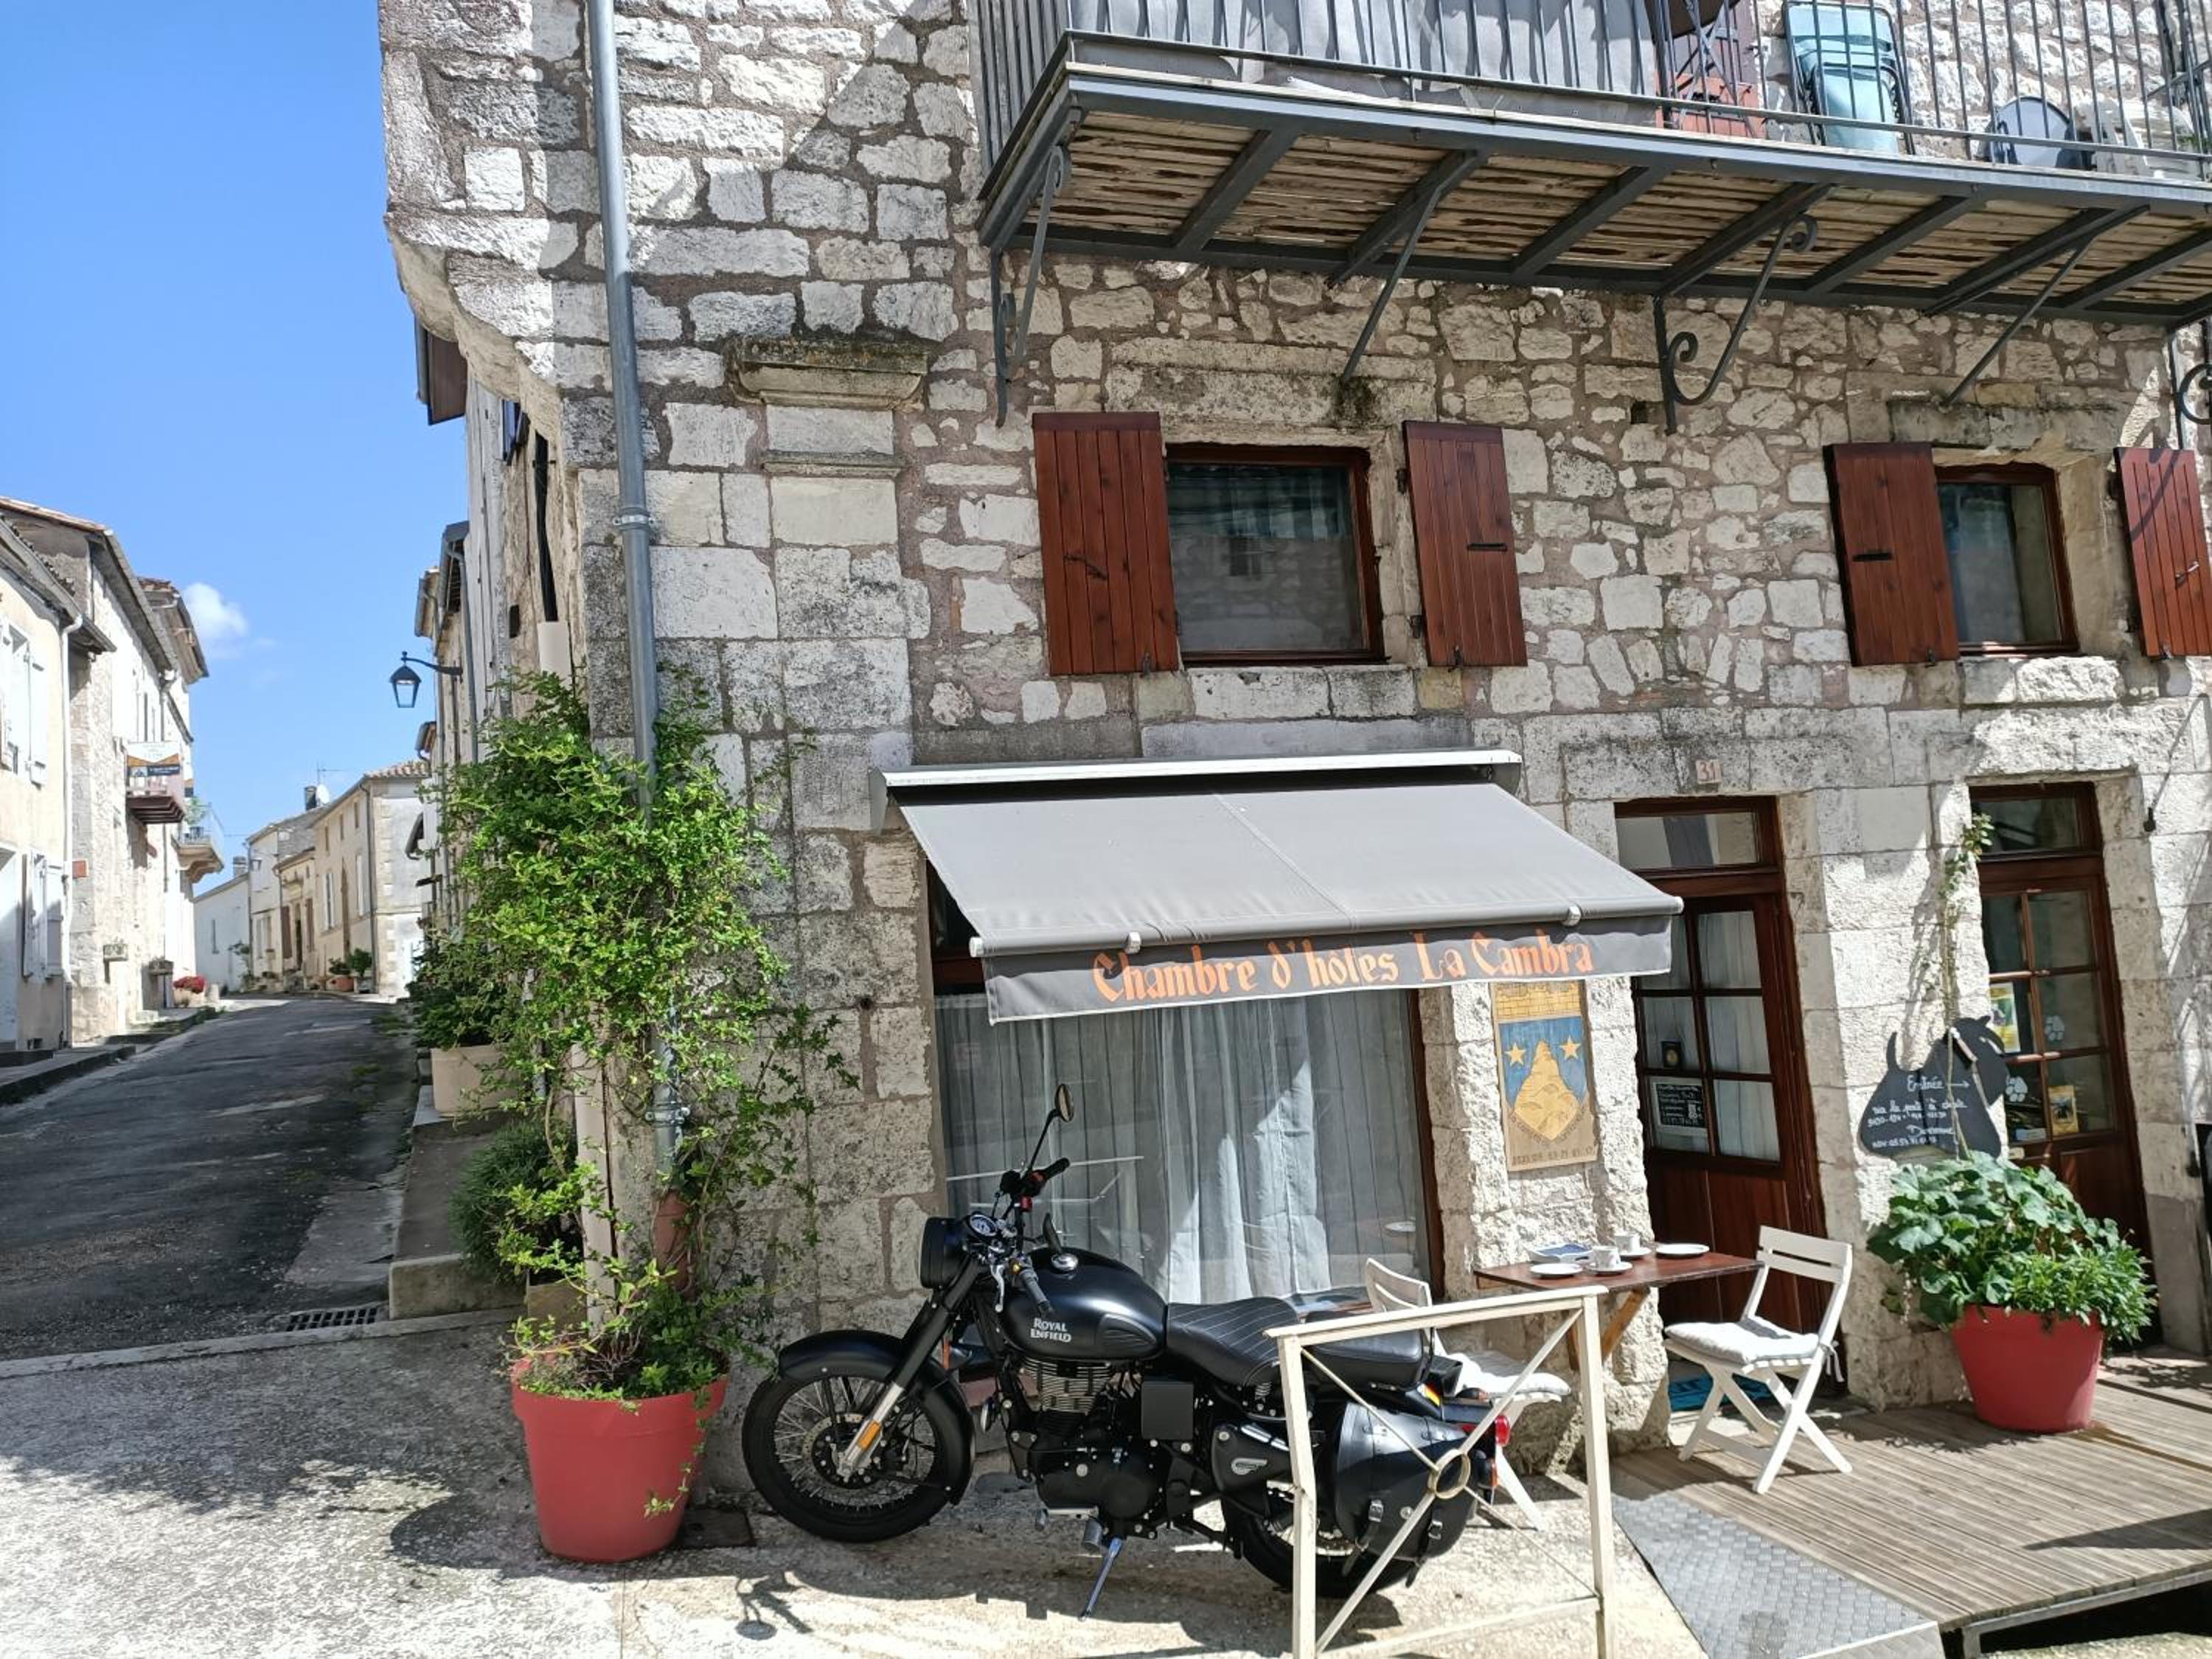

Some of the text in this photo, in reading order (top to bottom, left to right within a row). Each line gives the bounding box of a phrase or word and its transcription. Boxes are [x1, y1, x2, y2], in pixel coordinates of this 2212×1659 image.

[1092, 945, 1258, 1002] Chambre
[1412, 931, 1467, 980] La
[1471, 928, 1593, 975] Cambra
[1034, 1318, 1068, 1332] ROYAL
[1030, 1329, 1071, 1342] ENFIELD
